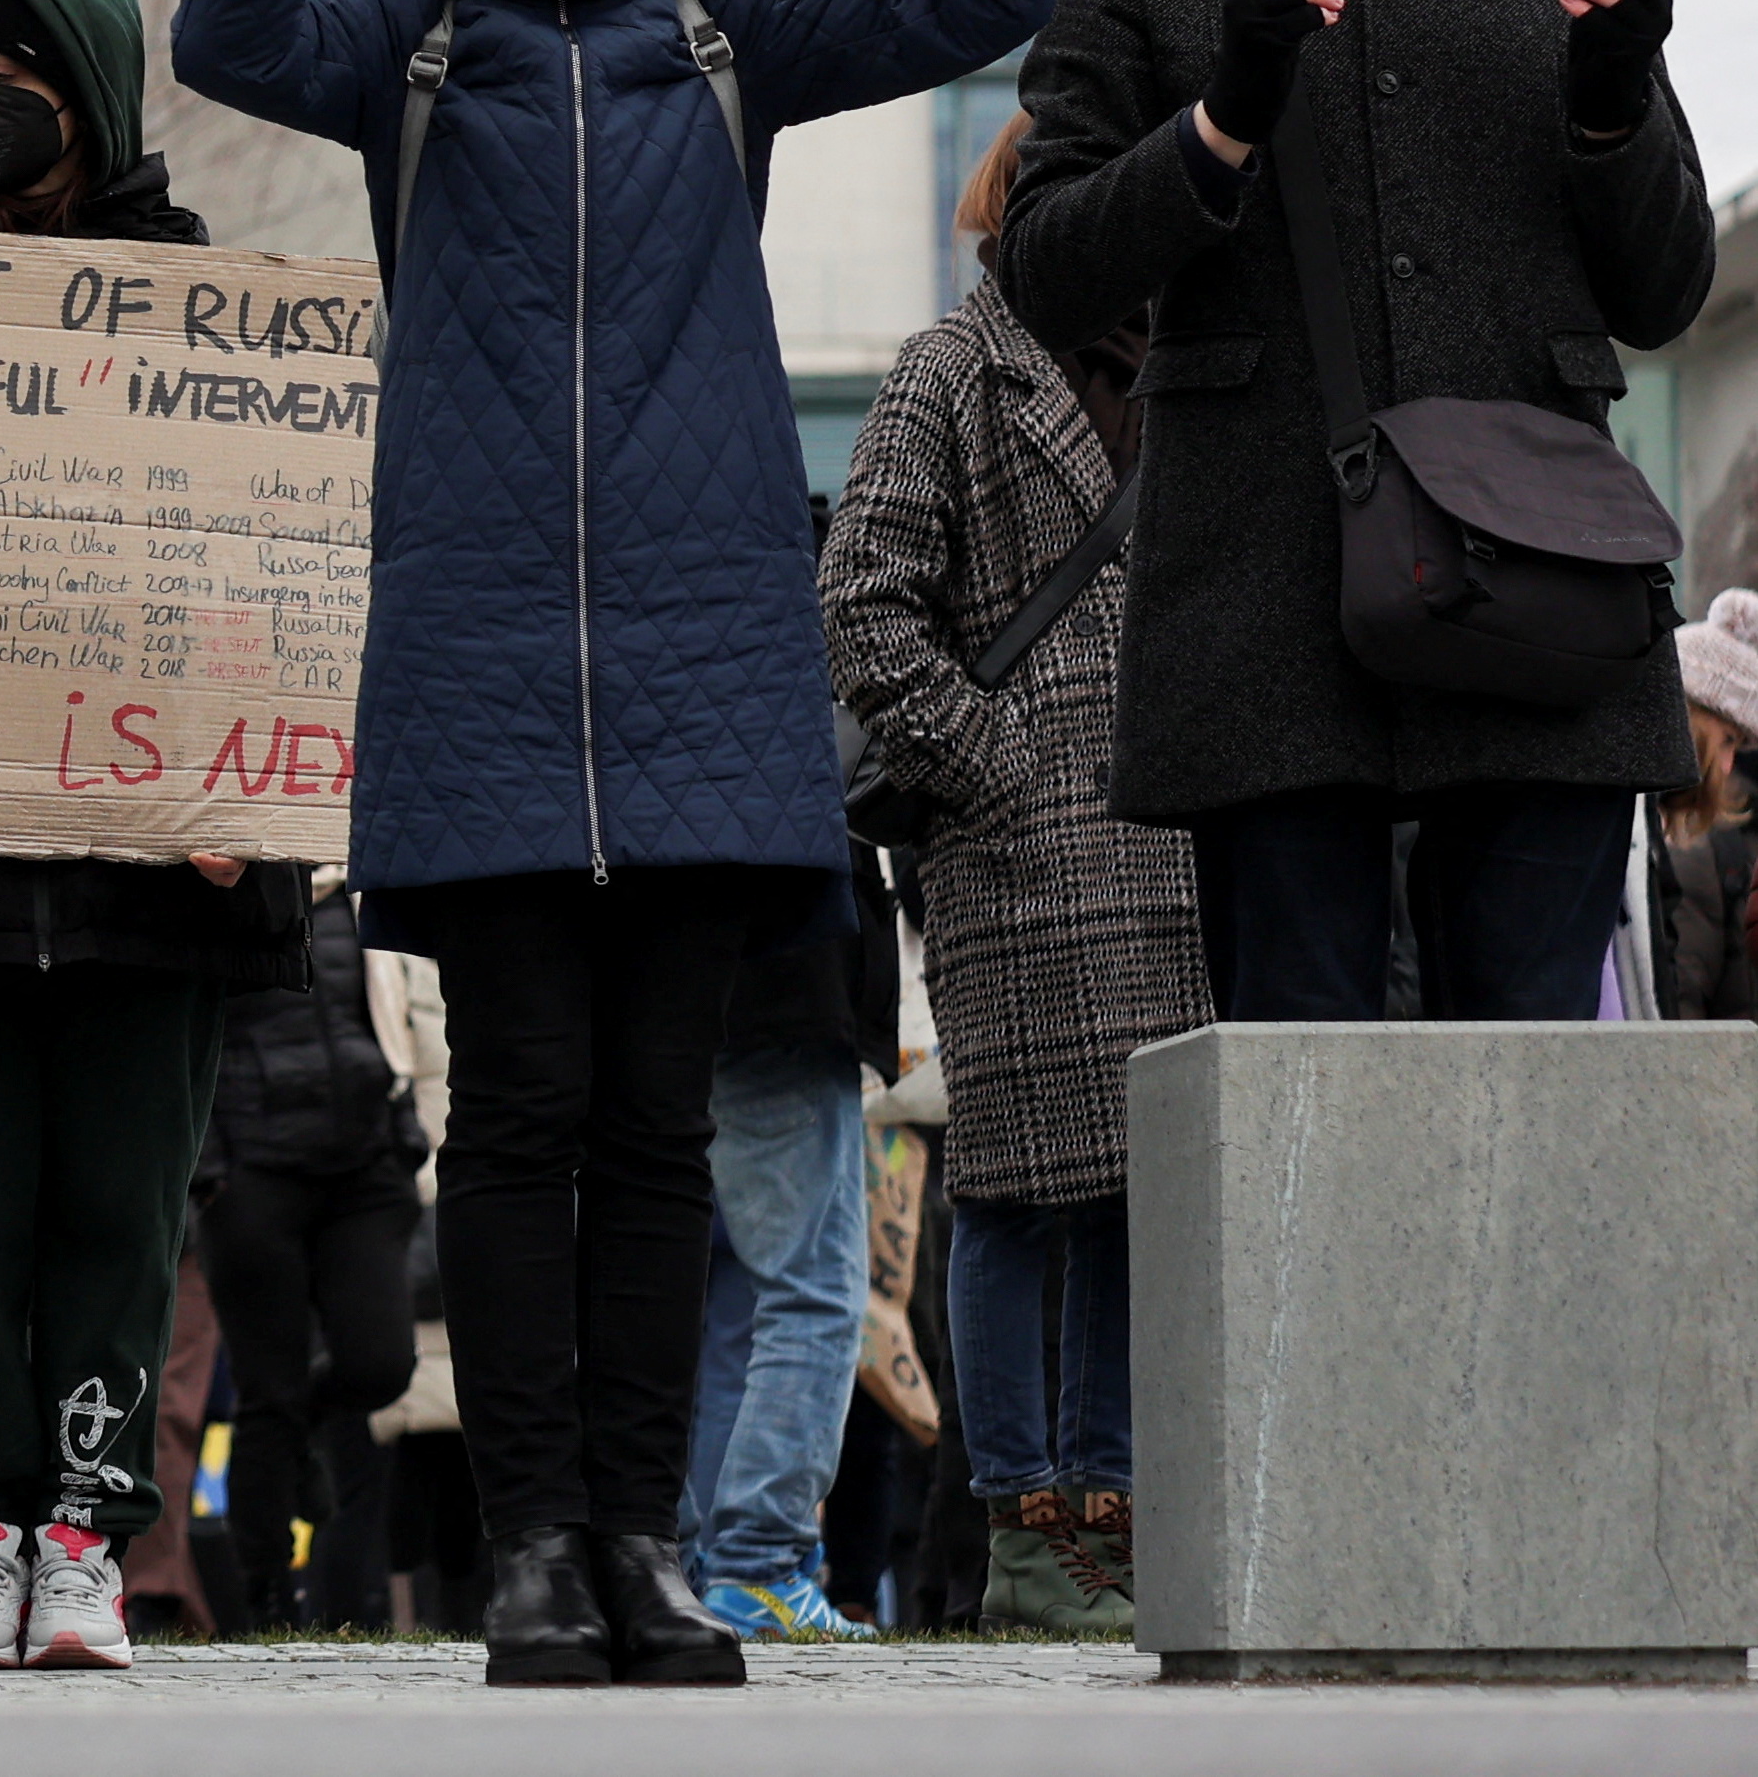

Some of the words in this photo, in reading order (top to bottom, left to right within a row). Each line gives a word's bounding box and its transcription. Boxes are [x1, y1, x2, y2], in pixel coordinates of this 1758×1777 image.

[61, 266, 152, 337] OF
[183, 283, 372, 359] RUSSI
[147, 540, 207, 568] 2008
